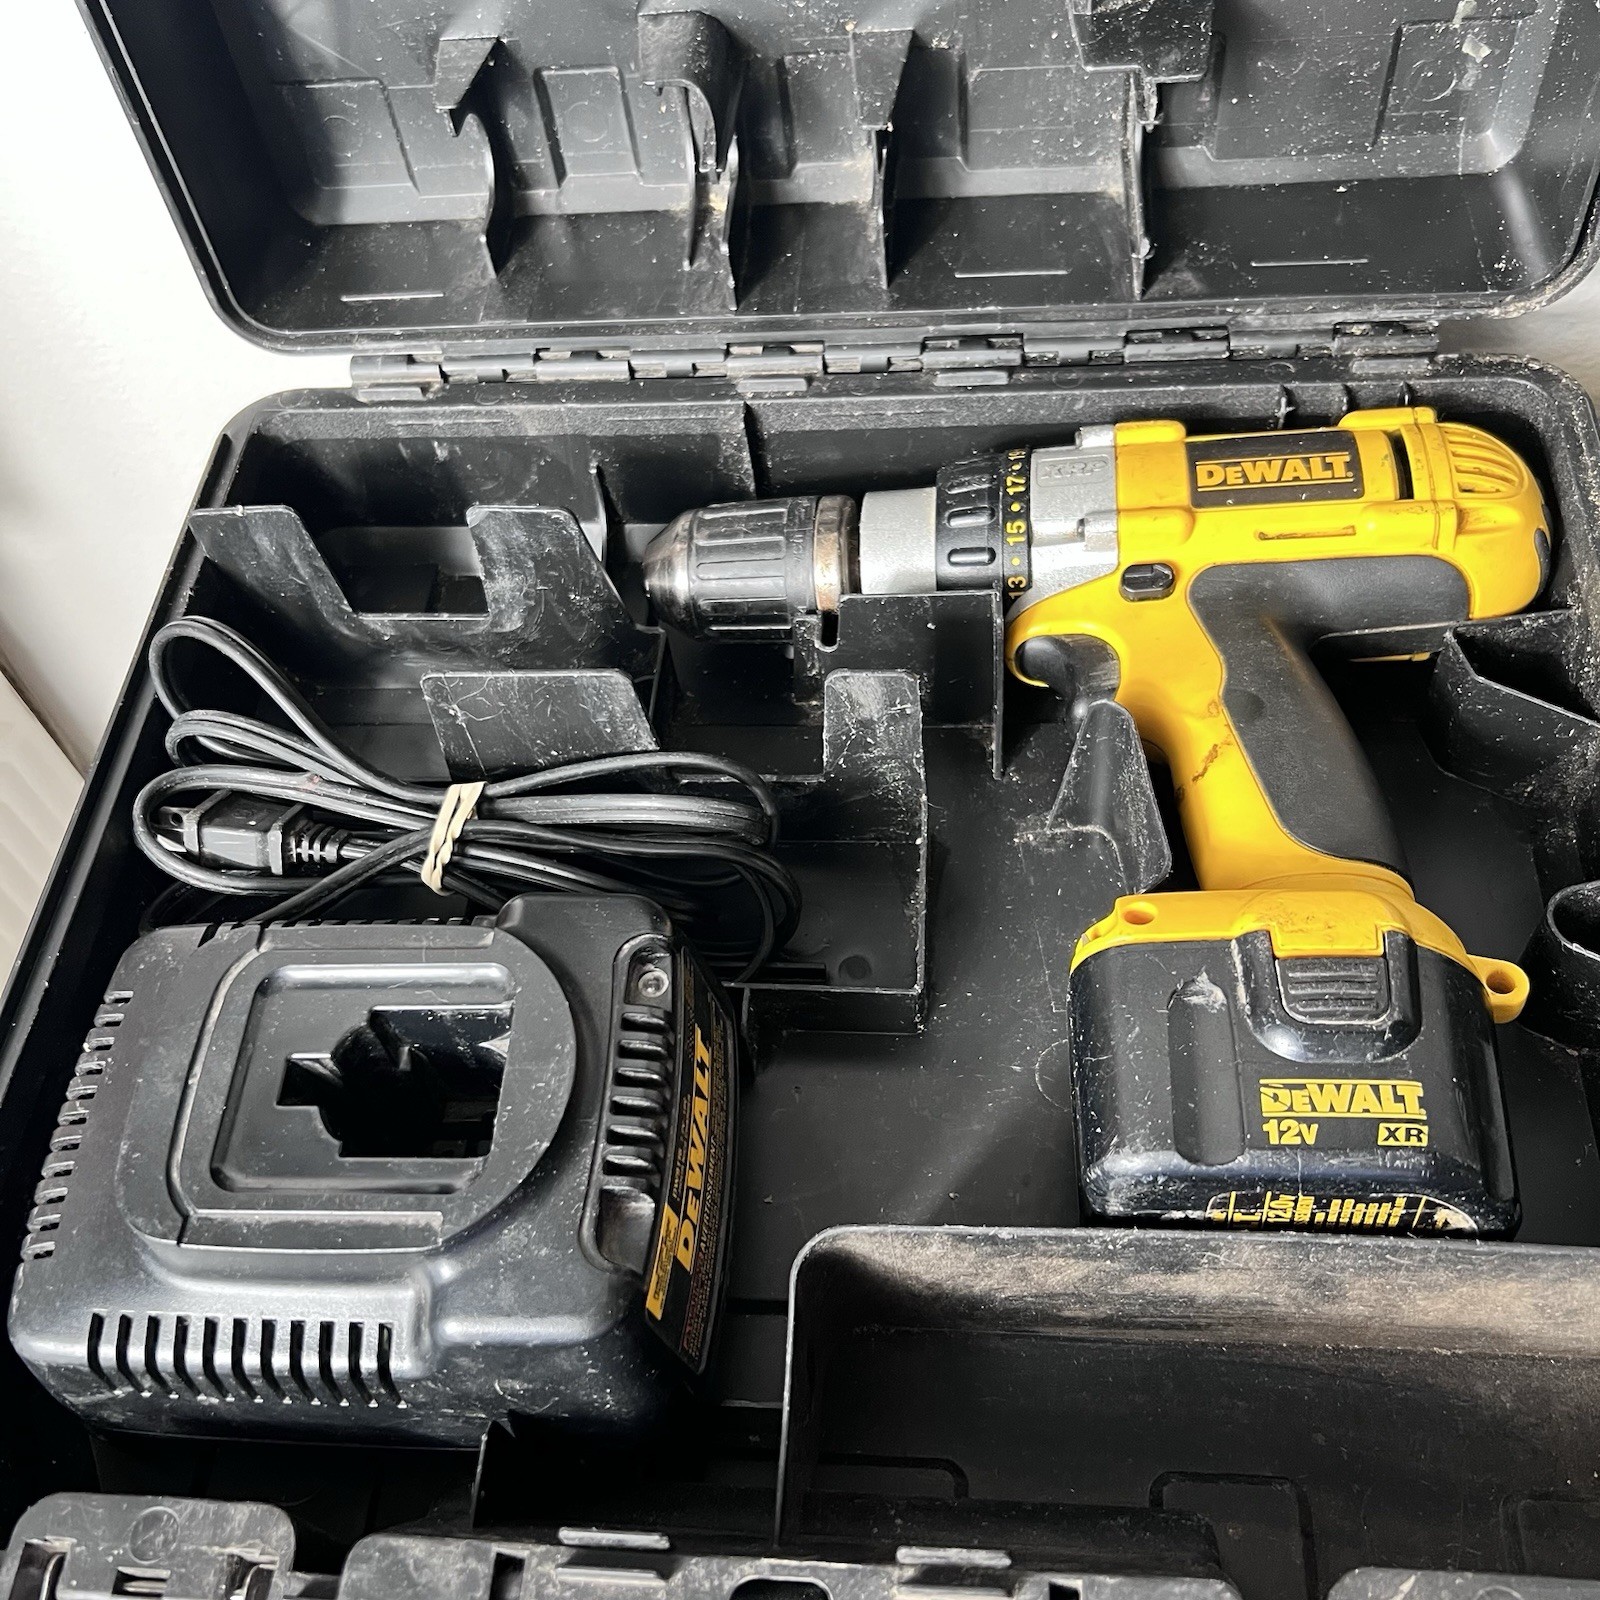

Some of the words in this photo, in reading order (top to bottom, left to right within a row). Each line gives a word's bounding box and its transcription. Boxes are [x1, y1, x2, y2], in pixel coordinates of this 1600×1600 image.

[1006, 475, 1027, 496] 17
[1006, 520, 1027, 546] 15
[1008, 576, 1026, 600] 13
[1381, 1126, 1425, 1143] XR
